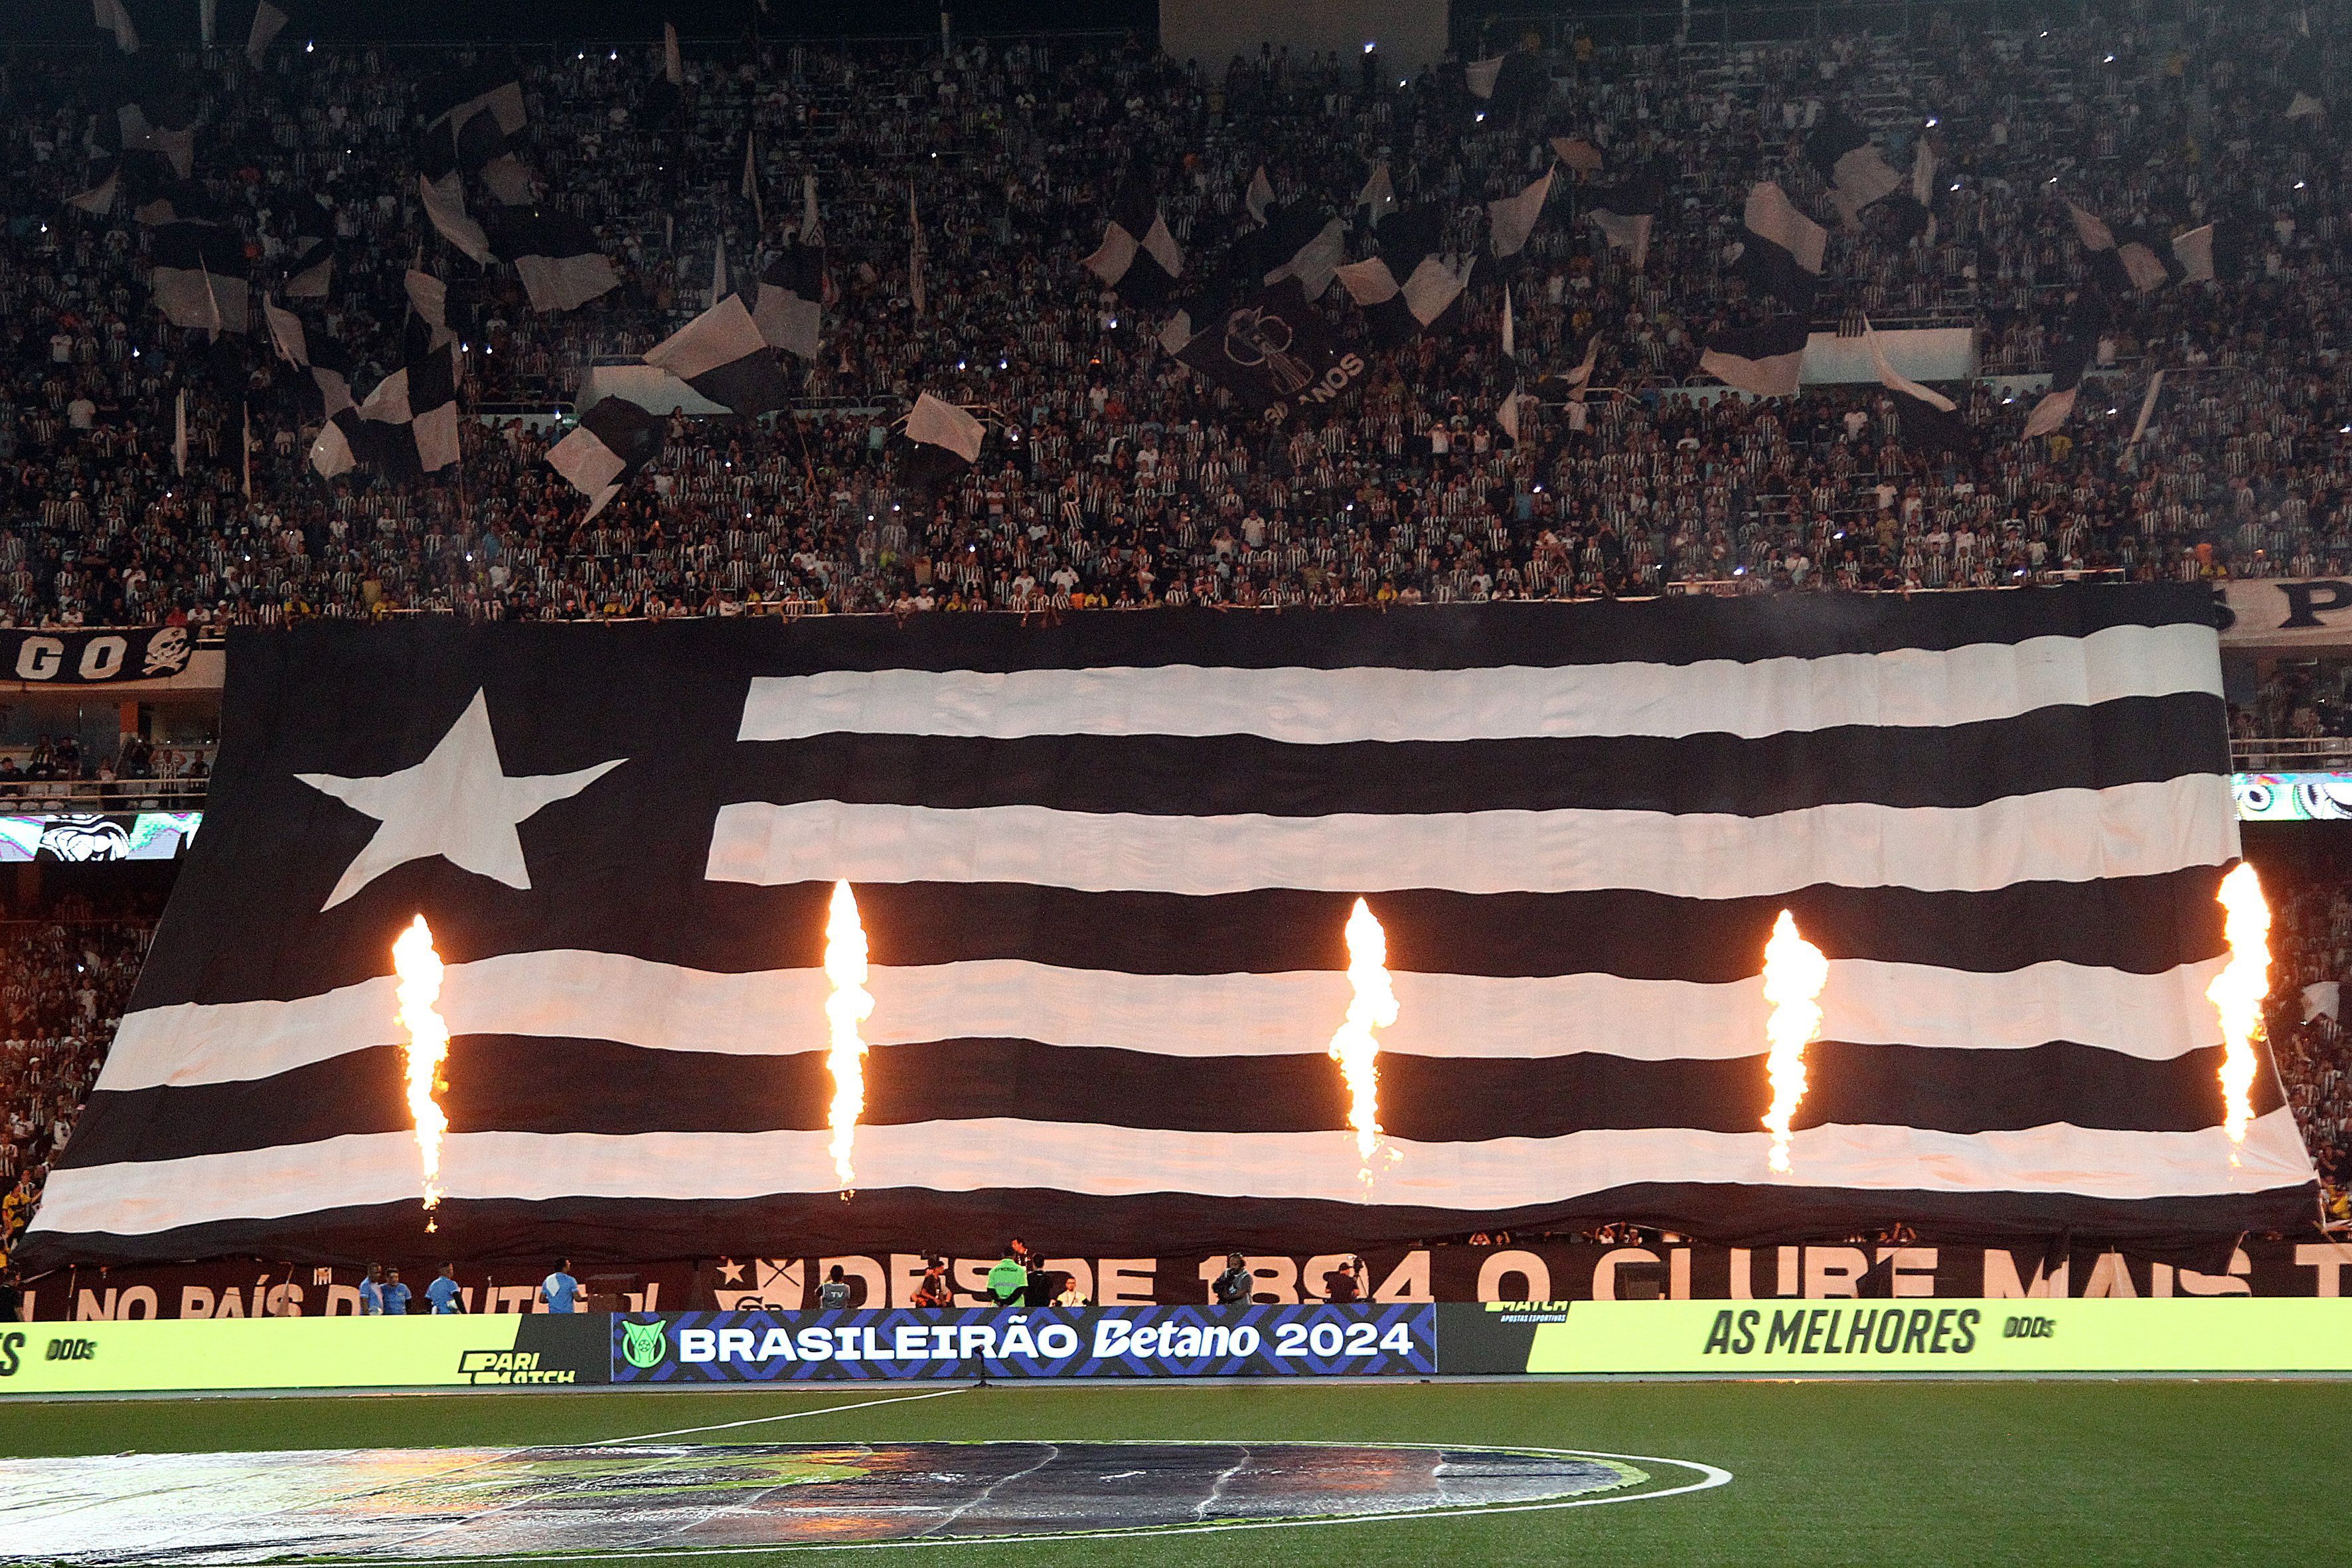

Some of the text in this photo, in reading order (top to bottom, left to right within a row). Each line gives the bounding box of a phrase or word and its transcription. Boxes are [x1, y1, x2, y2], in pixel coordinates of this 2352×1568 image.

[15, 635, 128, 680] GO
[76, 1285, 158, 1321] NO
[180, 1275, 303, 1319] PAÍS
[819, 1253, 1157, 1310] DESDE
[1199, 1250, 1435, 1306] 1894
[679, 1314, 1415, 1363] BRASILEIRÃO Betano 2024
[1702, 1310, 1761, 1355] AS
[1764, 1308, 1982, 1354] MELHORES
[465, 1352, 540, 1371] PARI
